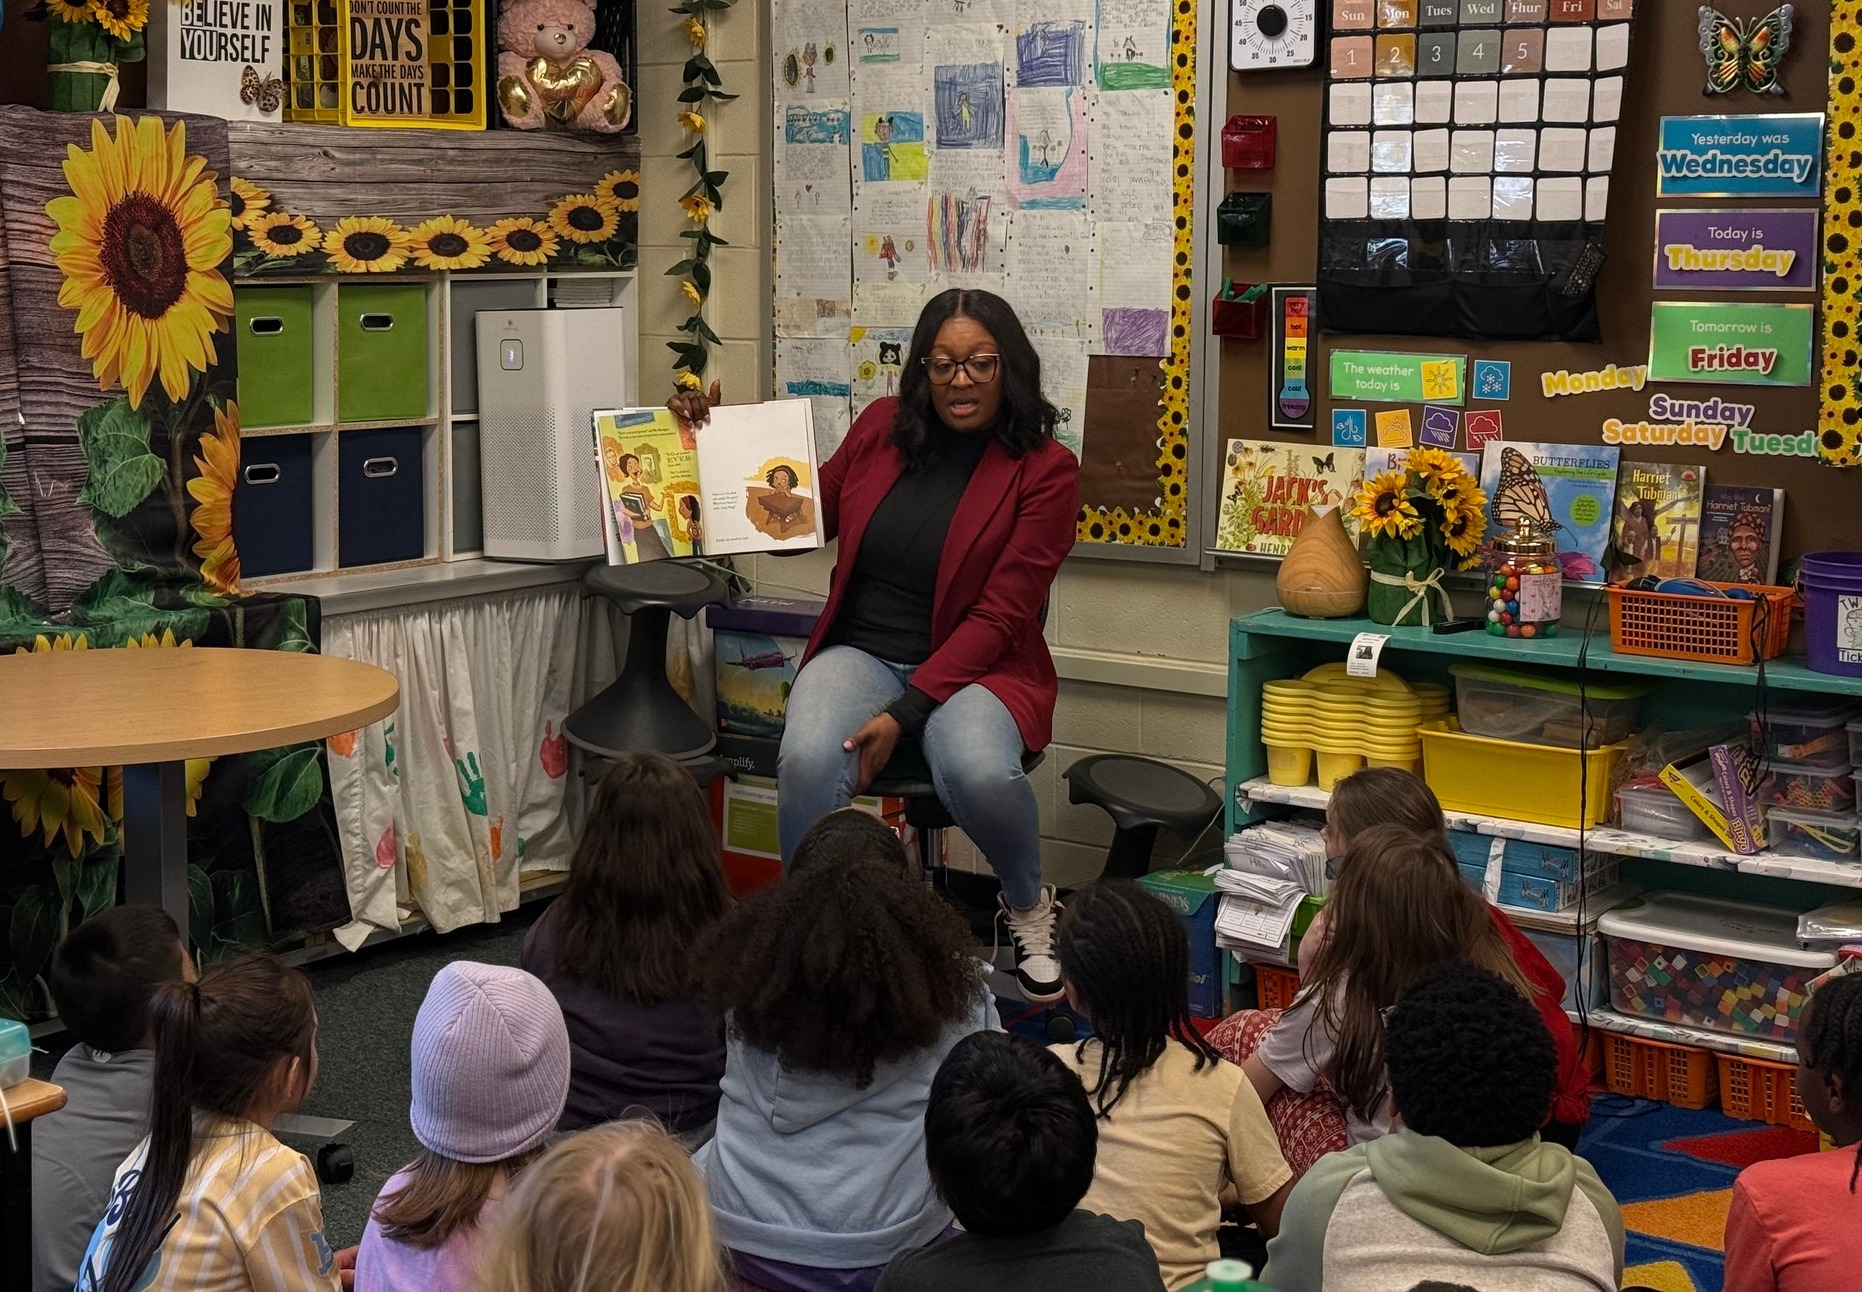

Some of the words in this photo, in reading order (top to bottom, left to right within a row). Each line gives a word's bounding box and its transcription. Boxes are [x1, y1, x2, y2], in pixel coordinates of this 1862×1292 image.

[376, 1, 404, 15] COUNT
[406, 2, 422, 16] THE
[1426, 5, 1452, 16] Tues
[1467, 3, 1494, 14] Wed
[1511, 3, 1541, 14] Thur
[1562, 1, 1583, 13] Fri
[1606, 0, 1623, 10] Sat
[181, 0, 250, 30] BELIEVE
[256, 3, 272, 31] IN
[1341, 10, 1365, 21] Sun
[1384, 9, 1410, 19] Mon
[1234, 19, 1243, 27] 45
[181, 28, 271, 63] YOURSELF
[350, 16, 423, 62] DAYS
[1251, 52, 1259, 60] 35
[1286, 49, 1295, 57] 25
[1347, 49, 1357, 66] 1
[1390, 46, 1401, 63] 2
[1431, 45, 1441, 62] 3
[1472, 43, 1484, 59] 4
[1517, 42, 1528, 60] 5
[1268, 56, 1277, 64] 30
[351, 63, 377, 78] MAKE
[378, 63, 397, 79] THE
[400, 64, 424, 80] DAYS
[351, 81, 425, 115] COUNT
[1691, 132, 1758, 147] Yesterday
[1761, 133, 1790, 144] was
[1658, 150, 1812, 182] Wednesday
[1707, 226, 1748, 242] Today
[1751, 227, 1764, 239] is
[1666, 245, 1795, 275] Thursday
[1690, 320, 1757, 333] Tomorrow
[1759, 321, 1772, 333] is
[1690, 344, 1776, 373] Friday
[1343, 362, 1365, 374] The
[1366, 364, 1414, 377] weather
[1355, 379, 1387, 393] today
[1389, 380, 1400, 391] is
[1543, 366, 1647, 396] Monday
[1282, 403, 1307, 412] freezing
[1651, 395, 1753, 426] Sunday
[1603, 420, 1726, 448] Saturday
[1731, 430, 1819, 456] Tuesd
[1532, 455, 1611, 470] BUTTERFLIES
[1632, 469, 1671, 485] Harriet
[1262, 475, 1329, 506] JACK'S
[1637, 485, 1680, 501] Tubman
[1706, 500, 1738, 511] Harriet
[1740, 502, 1772, 513] Tubman?
[1251, 505, 1308, 537] GARD
[1840, 597, 1862, 611] TW
[1722, 771, 1730, 789] Colors
[1690, 795, 1704, 811] Colors
[1709, 812, 1726, 832] Shapes
[1727, 795, 1737, 817] Shapes
[1731, 818, 1749, 852] Bingo
